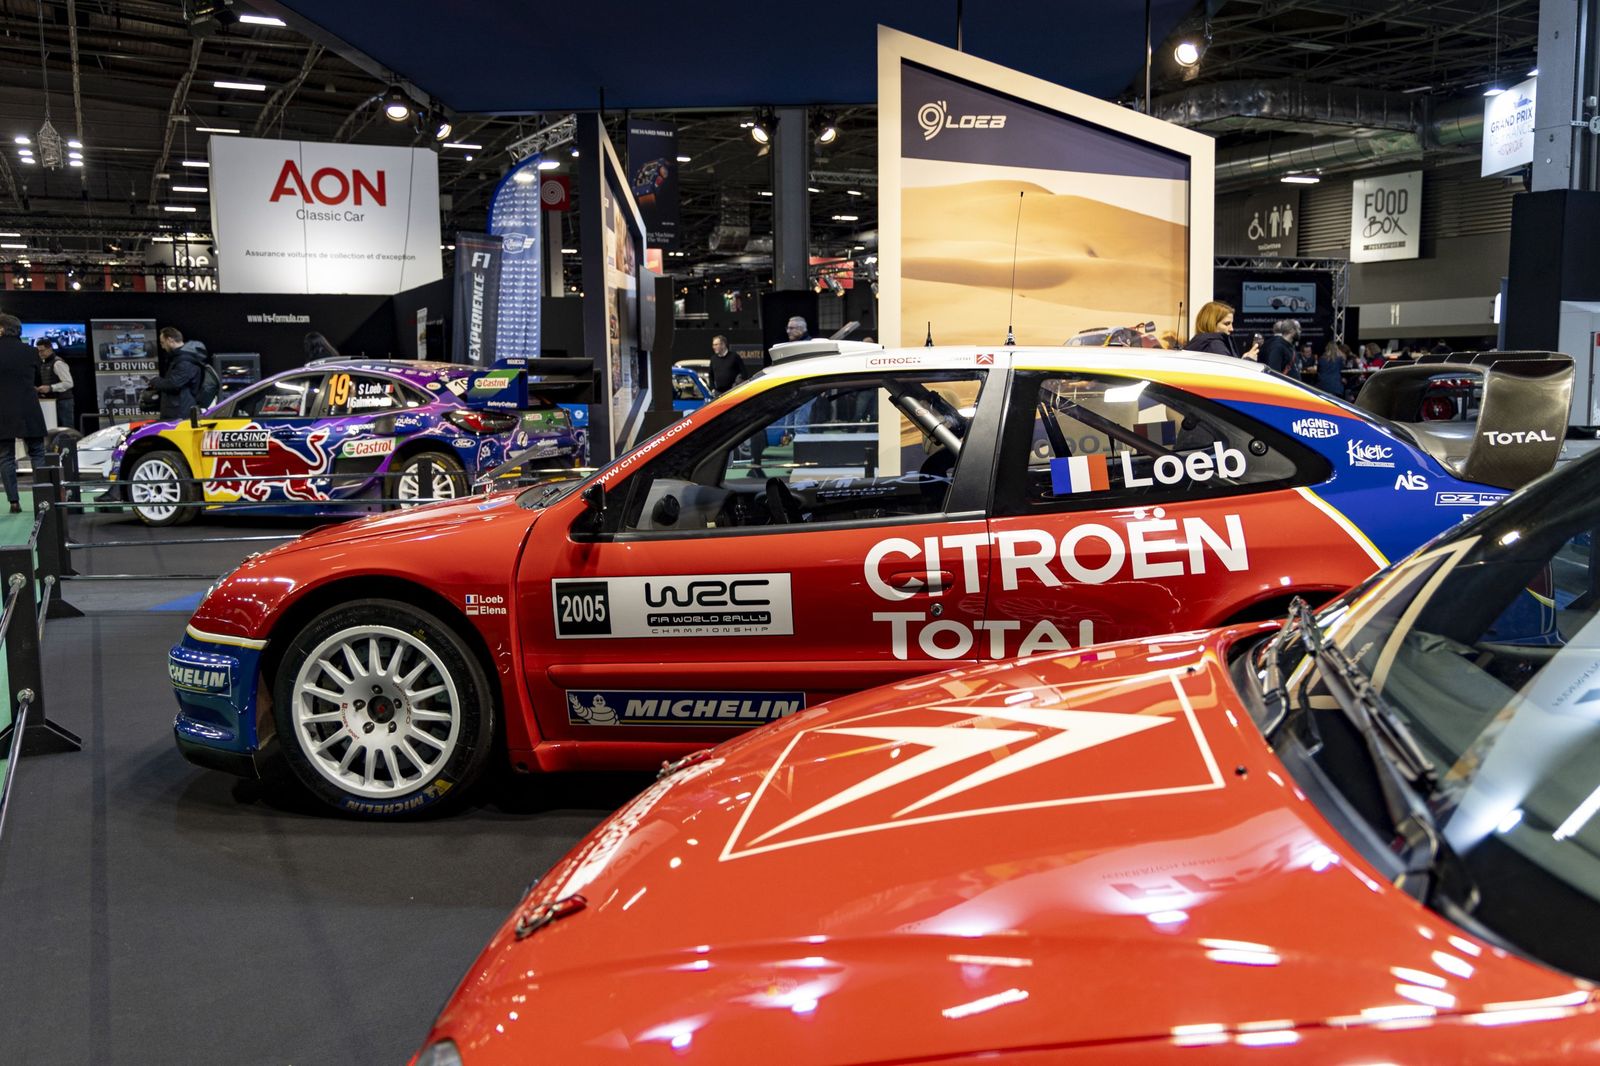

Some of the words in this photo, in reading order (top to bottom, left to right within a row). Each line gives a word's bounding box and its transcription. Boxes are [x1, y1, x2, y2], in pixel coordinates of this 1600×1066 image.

[945, 115, 1007, 128] LOEB
[1490, 115, 1515, 133] GRAND
[1516, 107, 1533, 124] PRIX
[631, 128, 656, 136] RICHARD
[269, 159, 387, 207] AON
[1364, 187, 1409, 218] FOOD
[296, 209, 342, 222] Classic
[344, 211, 365, 222] Car
[1363, 215, 1409, 238] BOX
[245, 249, 286, 258] Assurance
[330, 253, 364, 261] collection
[375, 254, 417, 263] d'exception
[471, 251, 491, 269] F1
[468, 272, 485, 361] EXPERIENCE
[114, 362, 156, 370] DRIVING
[328, 374, 350, 406] 19
[358, 384, 365, 395] S
[365, 382, 381, 395] Loeb
[1292, 418, 1339, 434] MAGNETI
[1292, 427, 1339, 439] MARELLI
[230, 432, 268, 443] CASINO
[1482, 429, 1556, 446] TOTAL
[356, 440, 392, 455] Castrol
[1346, 439, 1394, 466] Kinetic
[1121, 441, 1247, 489] Loeb
[863, 506, 1250, 601] CITROËN
[479, 595, 504, 604] Loeb
[645, 580, 771, 607] WRC
[479, 606, 507, 615] Elena
[561, 595, 606, 622] 2005
[650, 616, 672, 625] FIA
[674, 615, 720, 625] WORLD
[723, 614, 769, 623] RALLY
[651, 626, 769, 634] CHAMPIONSHIP
[625, 699, 801, 719] MICHELIN
[346, 795, 424, 813] MICHELIN
